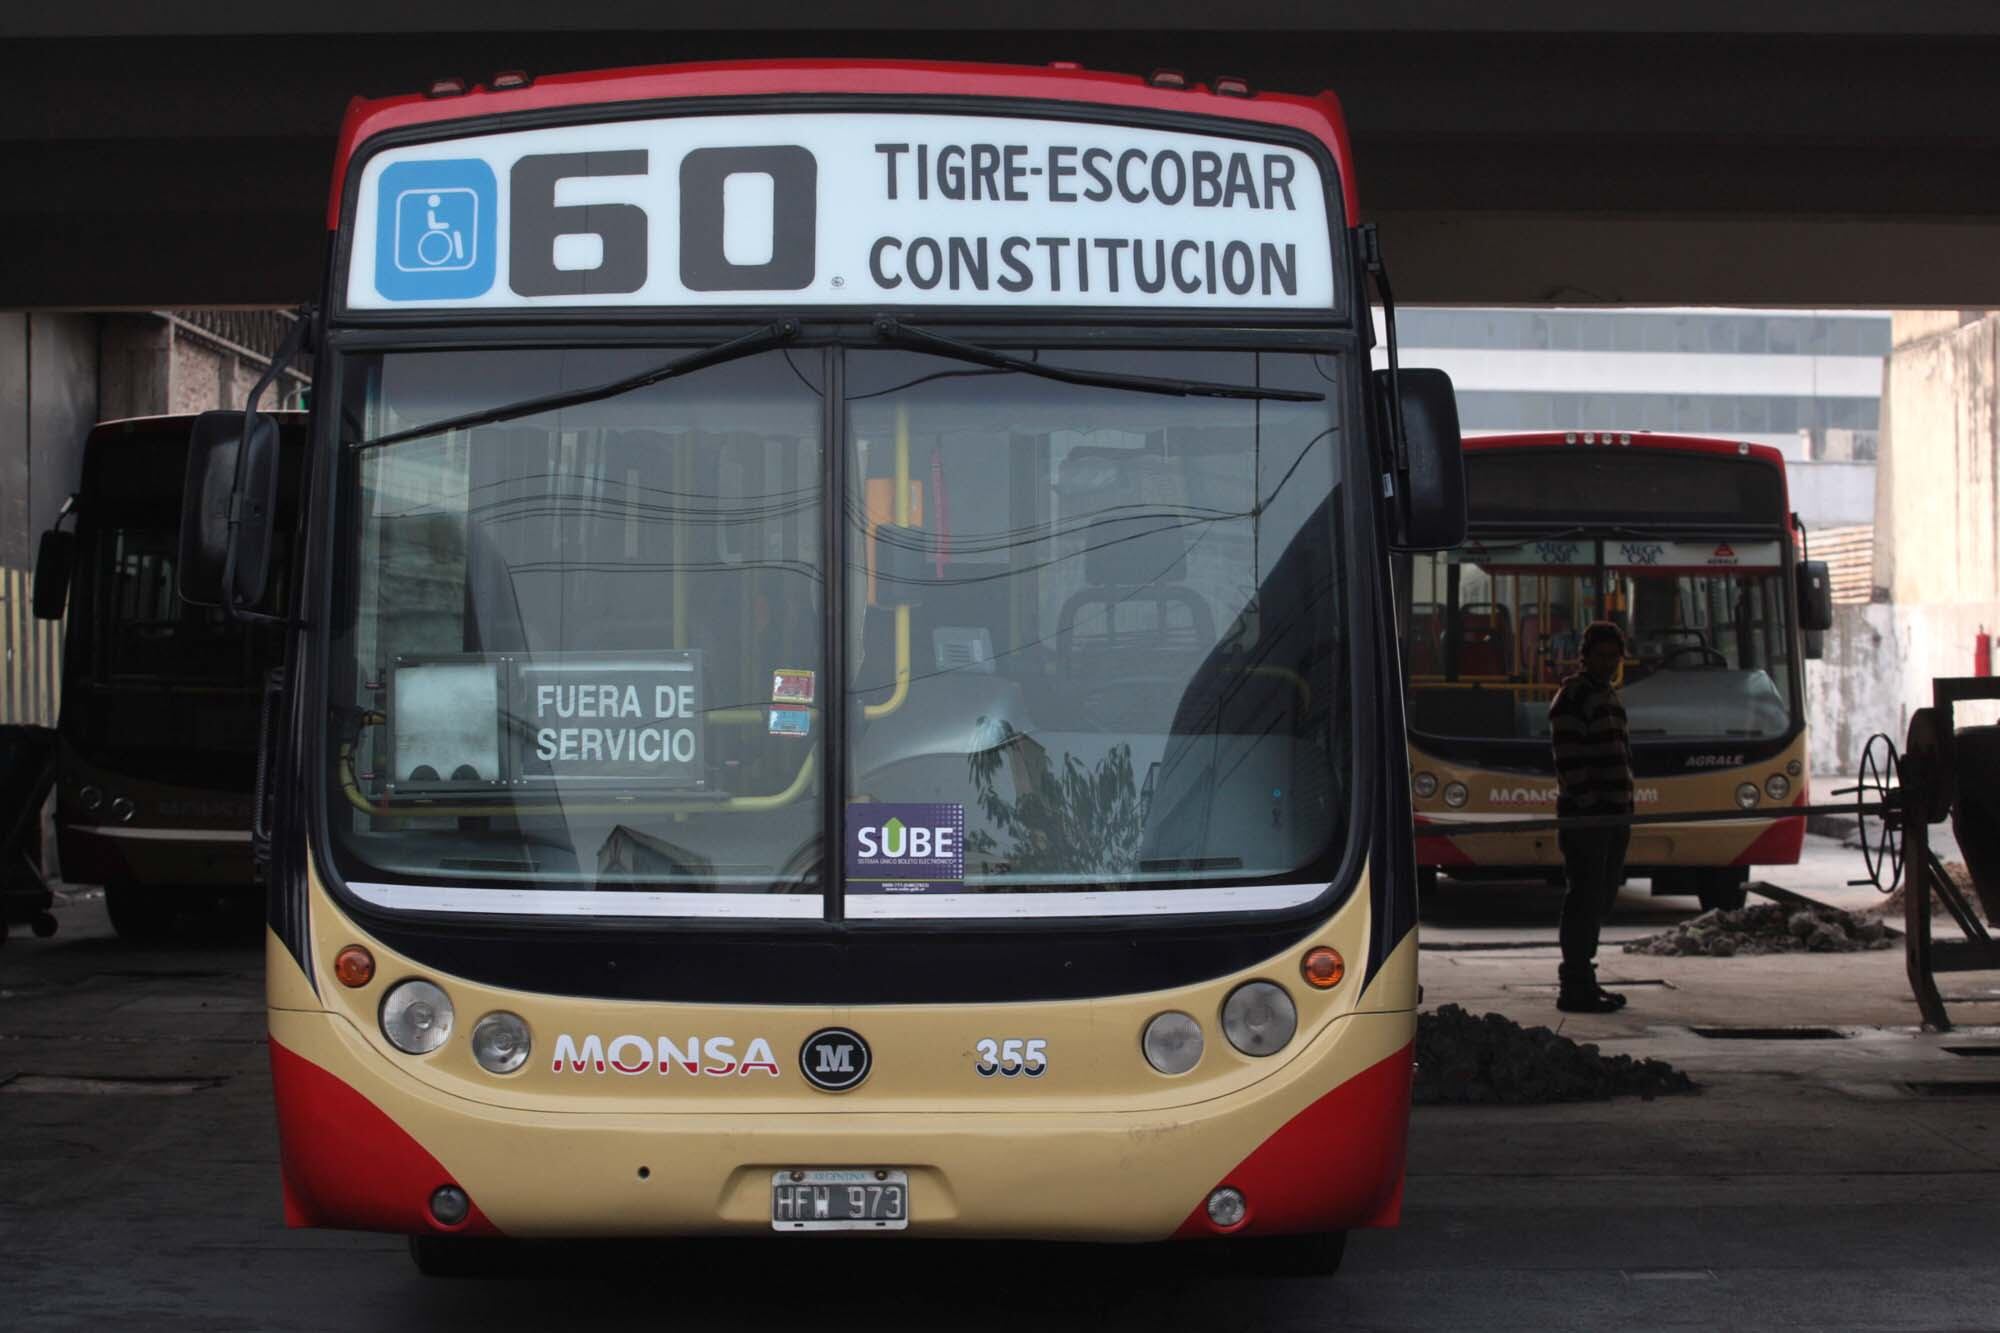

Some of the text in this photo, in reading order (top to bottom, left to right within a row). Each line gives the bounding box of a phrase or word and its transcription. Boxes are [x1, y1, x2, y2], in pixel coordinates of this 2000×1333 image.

[875, 141, 1298, 211] TIGRE-ESCOBAR
[508, 145, 818, 298] 60
[868, 235, 1299, 297] CONSTITUCION
[536, 684, 695, 718] FUERA DE
[535, 727, 696, 763] SERVICIO
[1685, 755, 1745, 767] AGRALE
[1488, 786, 1560, 806] MONS
[857, 825, 954, 858] SUBE
[552, 1034, 780, 1078] MONSA
[815, 1044, 855, 1073] M
[974, 1037, 1048, 1078] 355
[776, 1186, 902, 1218] HFW 973
